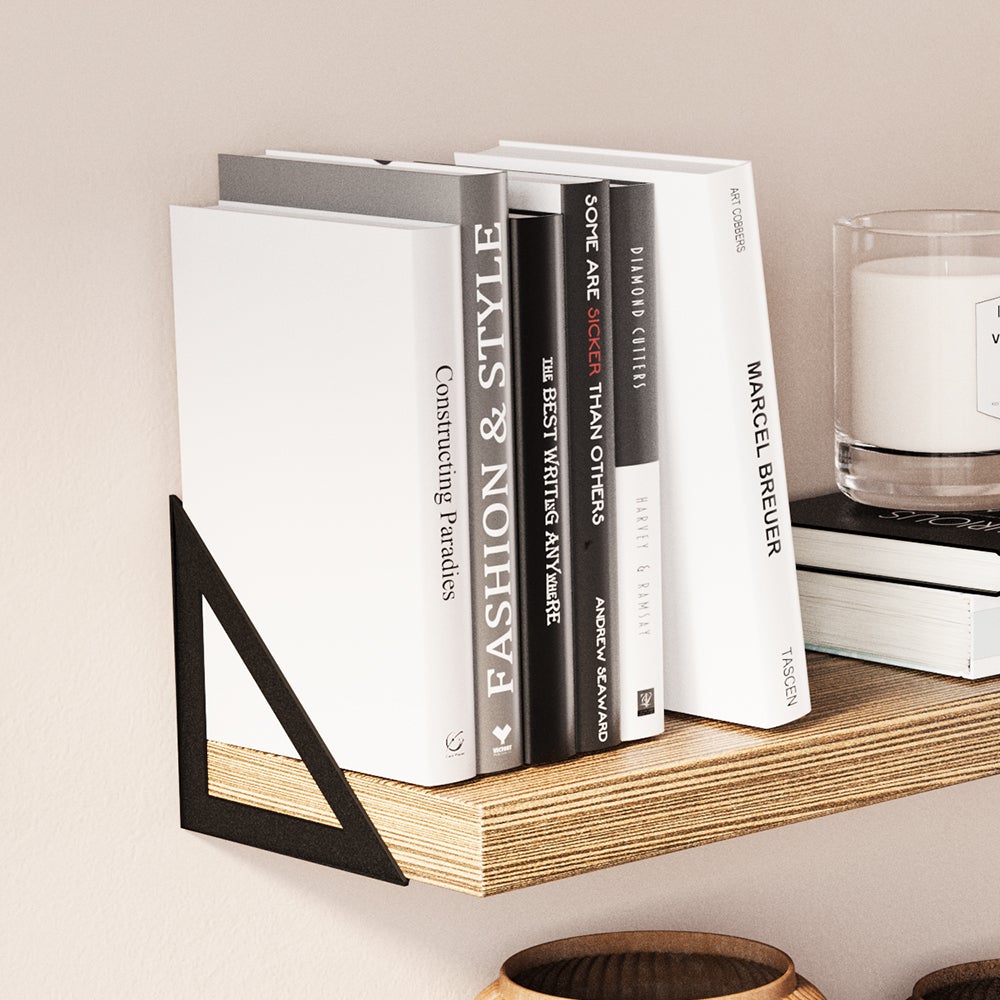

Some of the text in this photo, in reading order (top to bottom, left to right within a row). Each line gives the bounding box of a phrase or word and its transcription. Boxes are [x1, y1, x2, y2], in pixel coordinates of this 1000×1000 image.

[730, 187, 739, 207] ART
[585, 194, 604, 526] SOME ARE SICKER THAN OTHERS
[630, 247, 646, 389] DIAMOND CUTTERS
[997, 305, 1000, 318] I
[434, 364, 459, 601] Constructing Paradies
[475, 223, 513, 698] FASHION & STYLE
[542, 356, 560, 625] THE BEST WRITING ANYWHERE
[635, 496, 648, 550] HARVEY
[748, 361, 782, 557] MARCEL BREUER
[595, 596, 608, 742] ANDREW SEAWARD
[638, 582, 652, 636] RAMSAY
[781, 646, 798, 707] TASCEN
